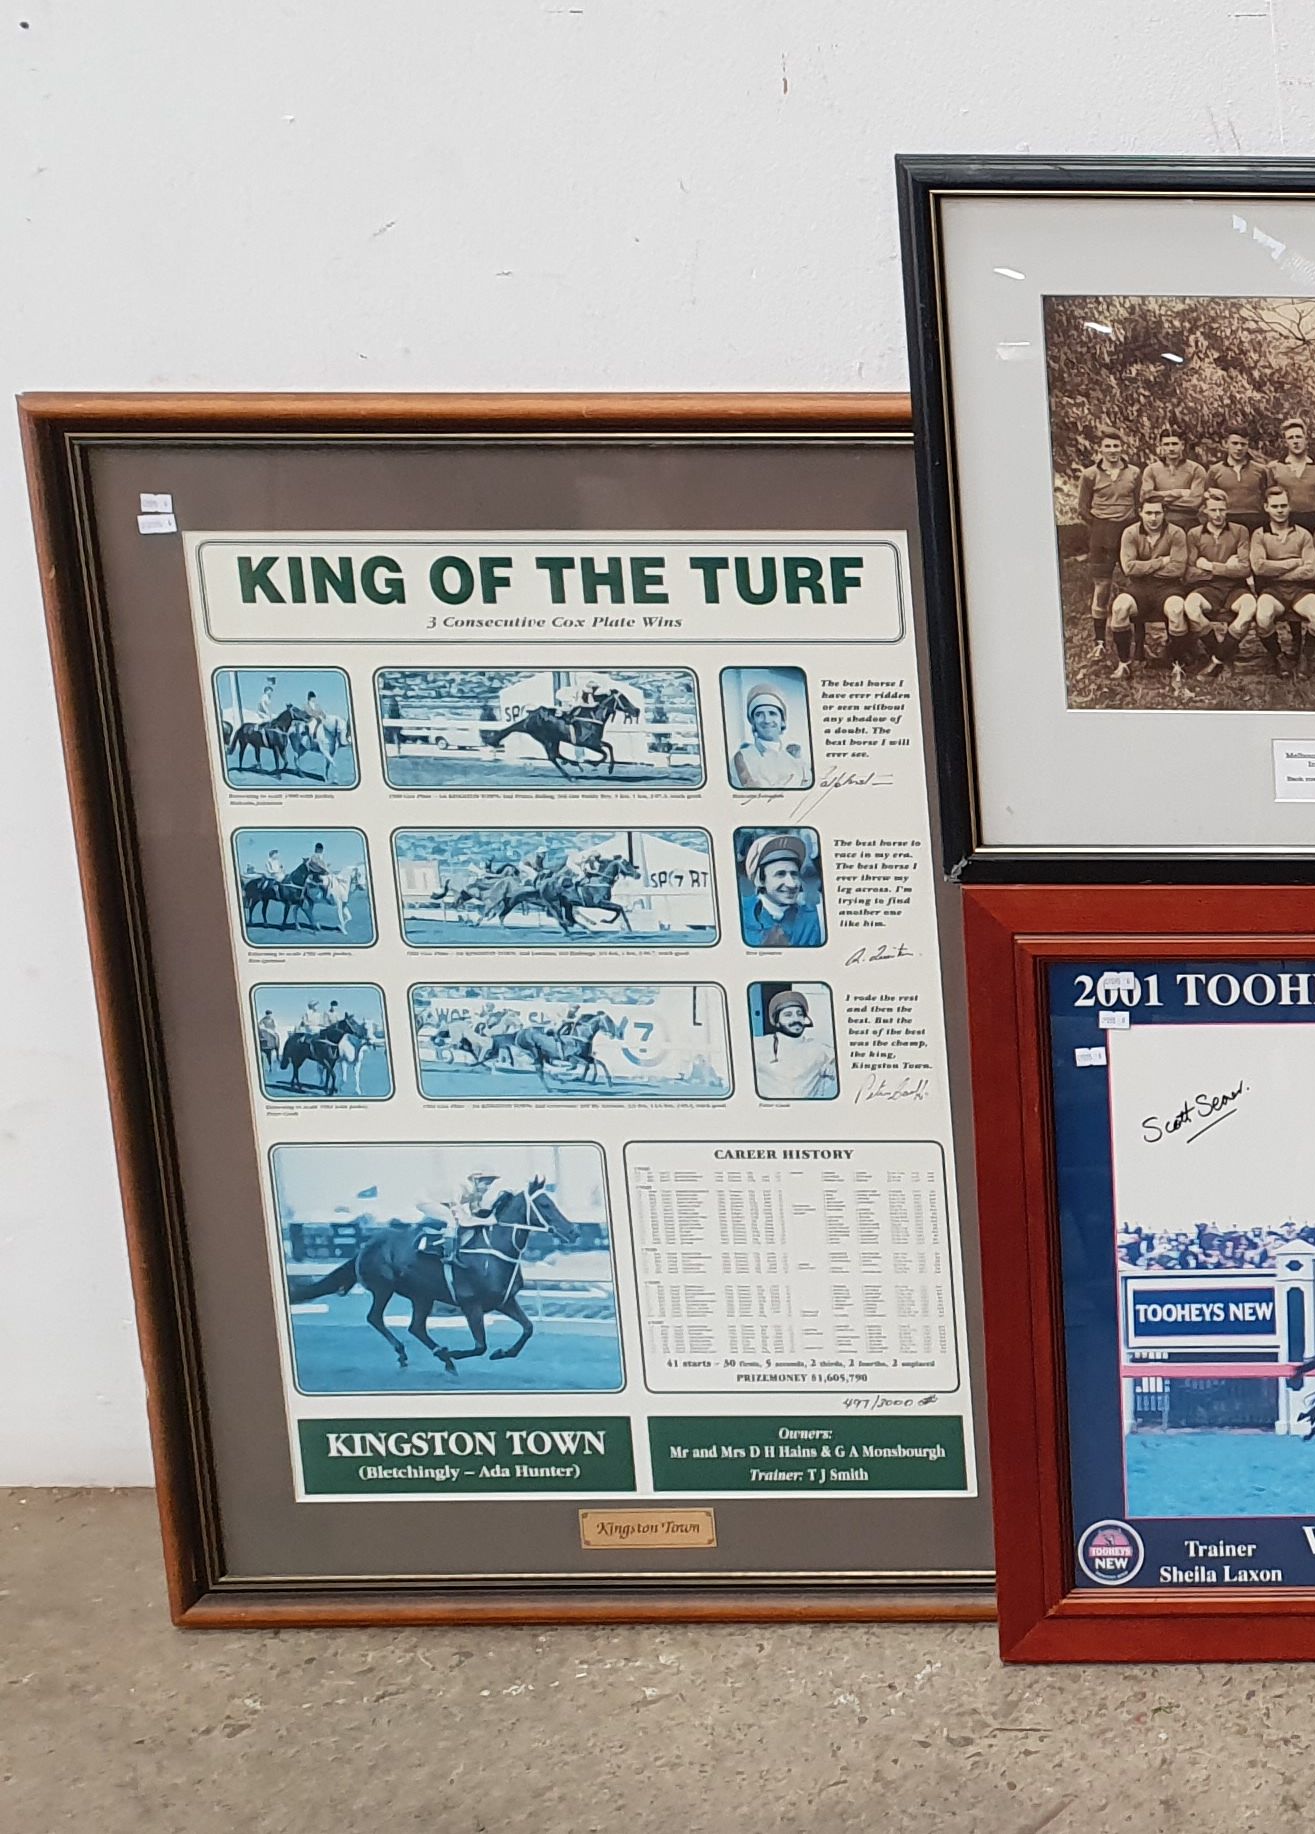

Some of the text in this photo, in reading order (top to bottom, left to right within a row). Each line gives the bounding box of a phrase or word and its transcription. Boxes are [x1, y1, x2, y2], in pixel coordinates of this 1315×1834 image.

[237, 556, 863, 605] KING OF THE TURF
[426, 616, 682, 629] 3 Consecutive Cox Plate Wins
[1073, 973, 1163, 1007] 2001
[713, 1149, 854, 1160] CAREER HISTORY
[1135, 1298, 1274, 1324] TOOHEYS NEW
[736, 1373, 808, 1383] PRIZEMONEY
[778, 1427, 833, 1440] Owners:
[327, 1431, 605, 1456] KINGSTON TOWN
[669, 1444, 945, 1460] Mr and Mrs D H Hains & G A Monsbourgh
[359, 1464, 580, 1481] (Bletchingly Ada Hunter)
[749, 1467, 869, 1483] Trainer: T J Smith
[596, 1521, 701, 1539] Kingston Town
[1089, 1546, 1133, 1557] TOOHEYS
[1185, 1541, 1256, 1557] Trainer
[1095, 1557, 1129, 1570] NEW
[1160, 1566, 1282, 1582] Sheila Laxon
